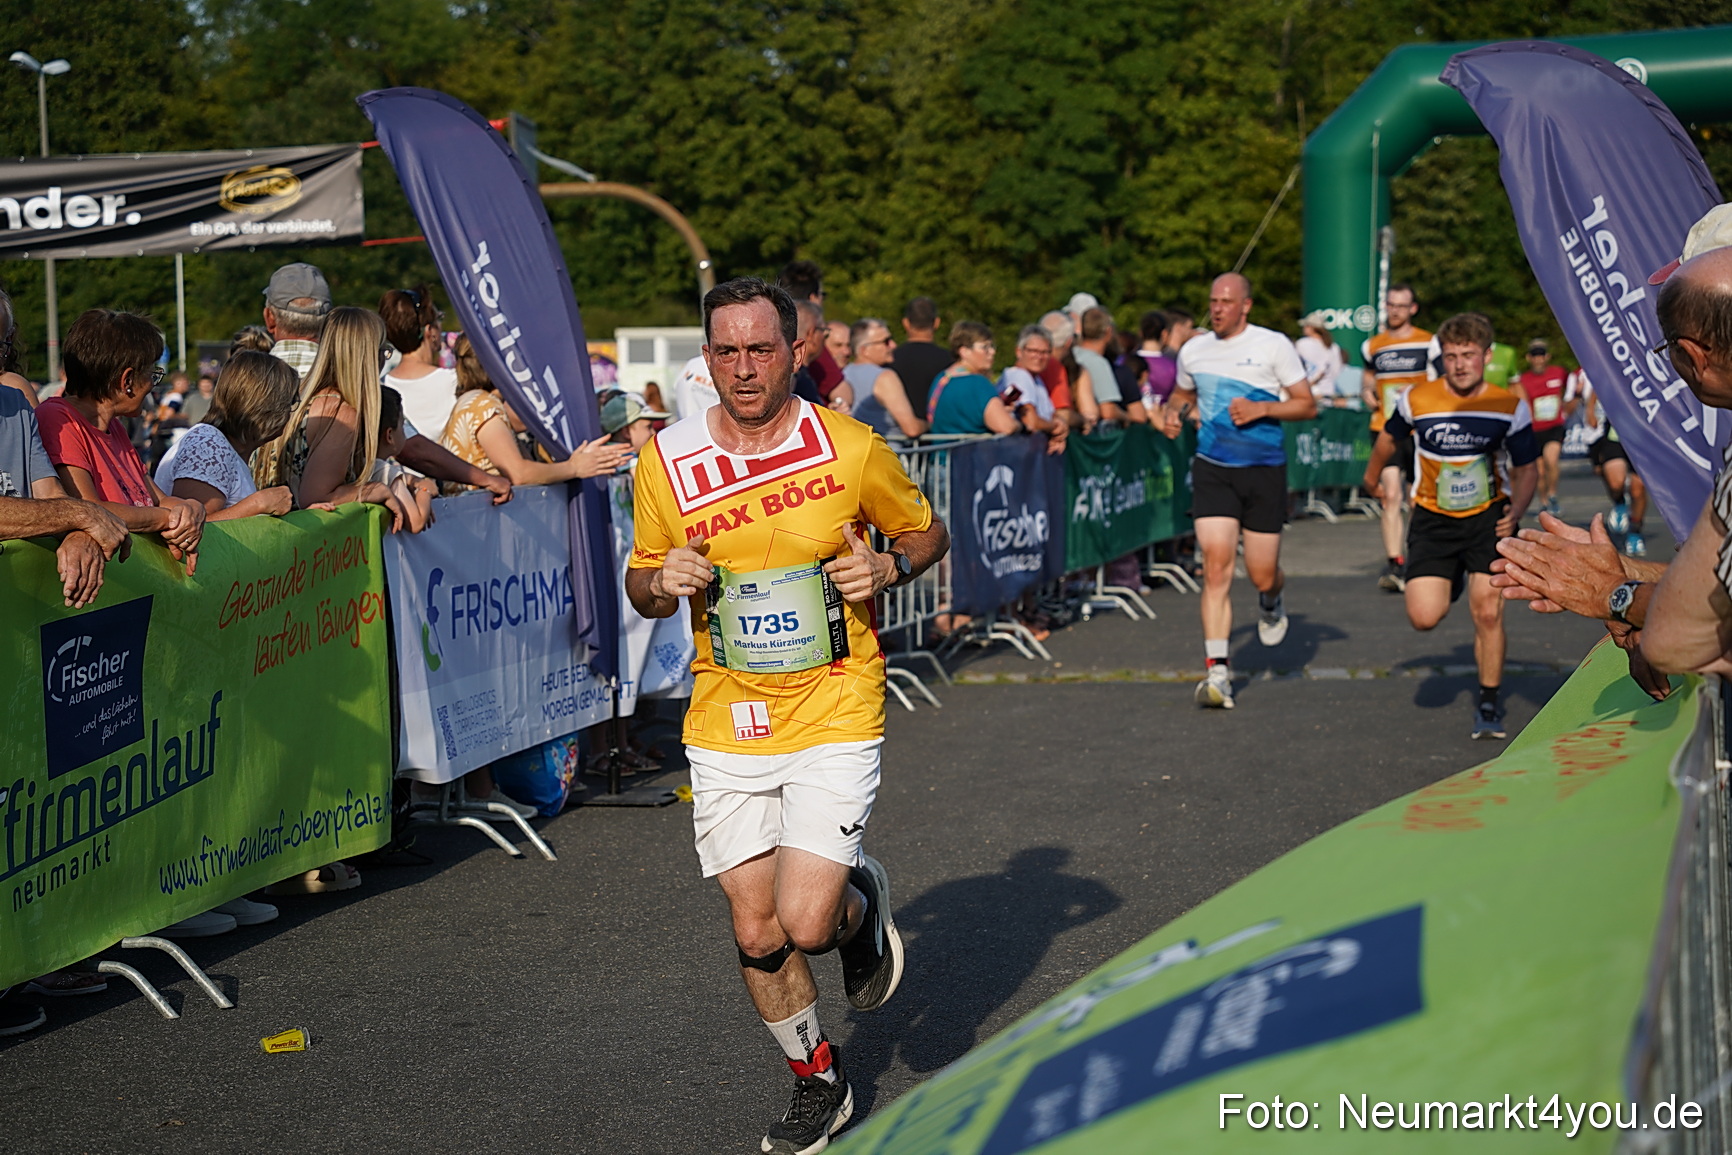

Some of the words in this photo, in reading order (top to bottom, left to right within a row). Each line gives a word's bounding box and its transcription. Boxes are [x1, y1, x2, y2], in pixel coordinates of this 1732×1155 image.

[1436, 432, 1491, 445] Fischer
[685, 503, 754, 542] MAX
[761, 474, 845, 517] BÖGL
[218, 546, 306, 630] Gesunde
[311, 535, 369, 588] Firmen
[253, 610, 312, 677] laufen
[316, 590, 385, 648] länger
[738, 611, 799, 635] 1735
[832, 622, 841, 653] HILTL
[734, 639, 768, 649] Markus
[770, 635, 816, 649] Kürzinger
[61, 650, 130, 693] Fischer
[541, 667, 569, 693] HEUTE
[68, 675, 124, 706] AUTOMOBILE
[542, 696, 579, 723] MORGEN
[4, 690, 222, 871] firmenlauf
[13, 834, 111, 912] neumarkt
